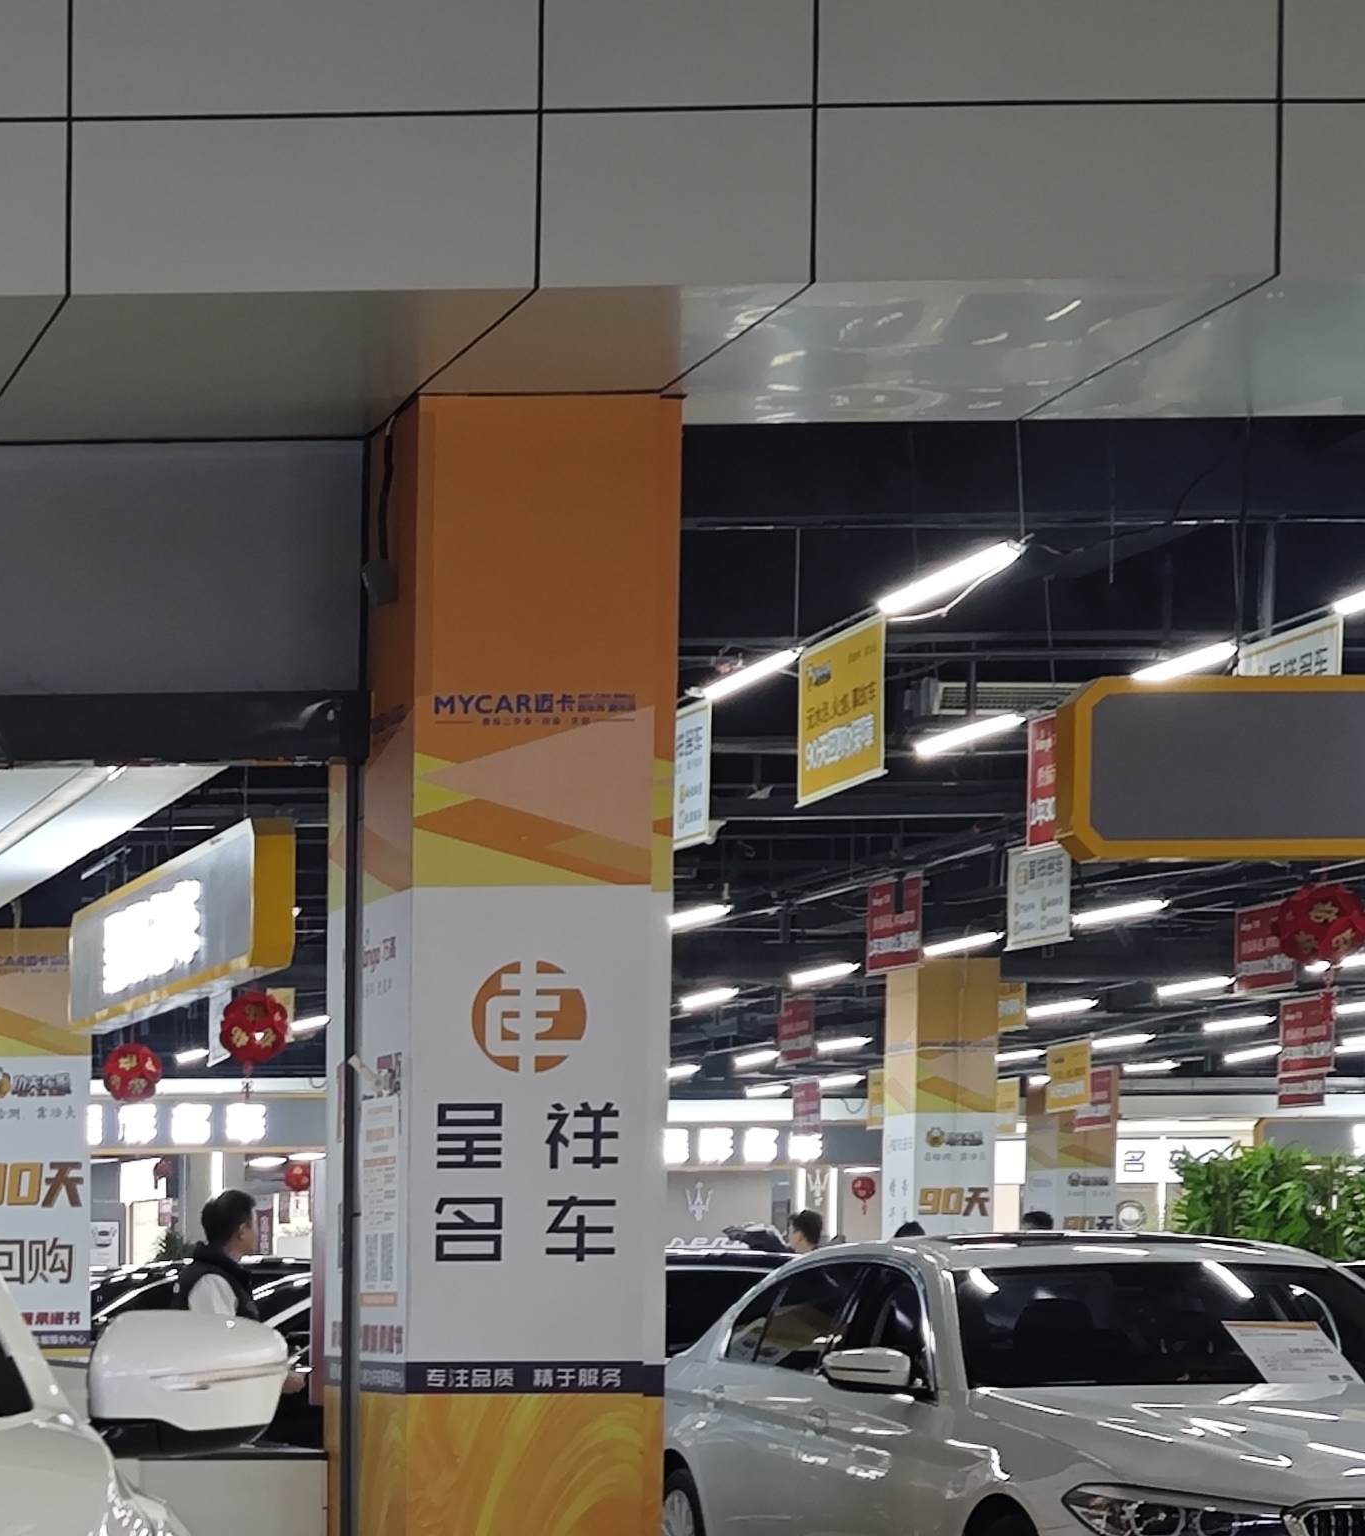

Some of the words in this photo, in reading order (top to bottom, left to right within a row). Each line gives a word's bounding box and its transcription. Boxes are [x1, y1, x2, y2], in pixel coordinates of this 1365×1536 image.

[435, 1100, 620, 1170] 呈祥
[918, 1186, 990, 1217] 90天
[435, 1195, 617, 1262] 名车
[426, 1367, 515, 1389] 专注品质
[532, 1367, 624, 1389] 精于服务
